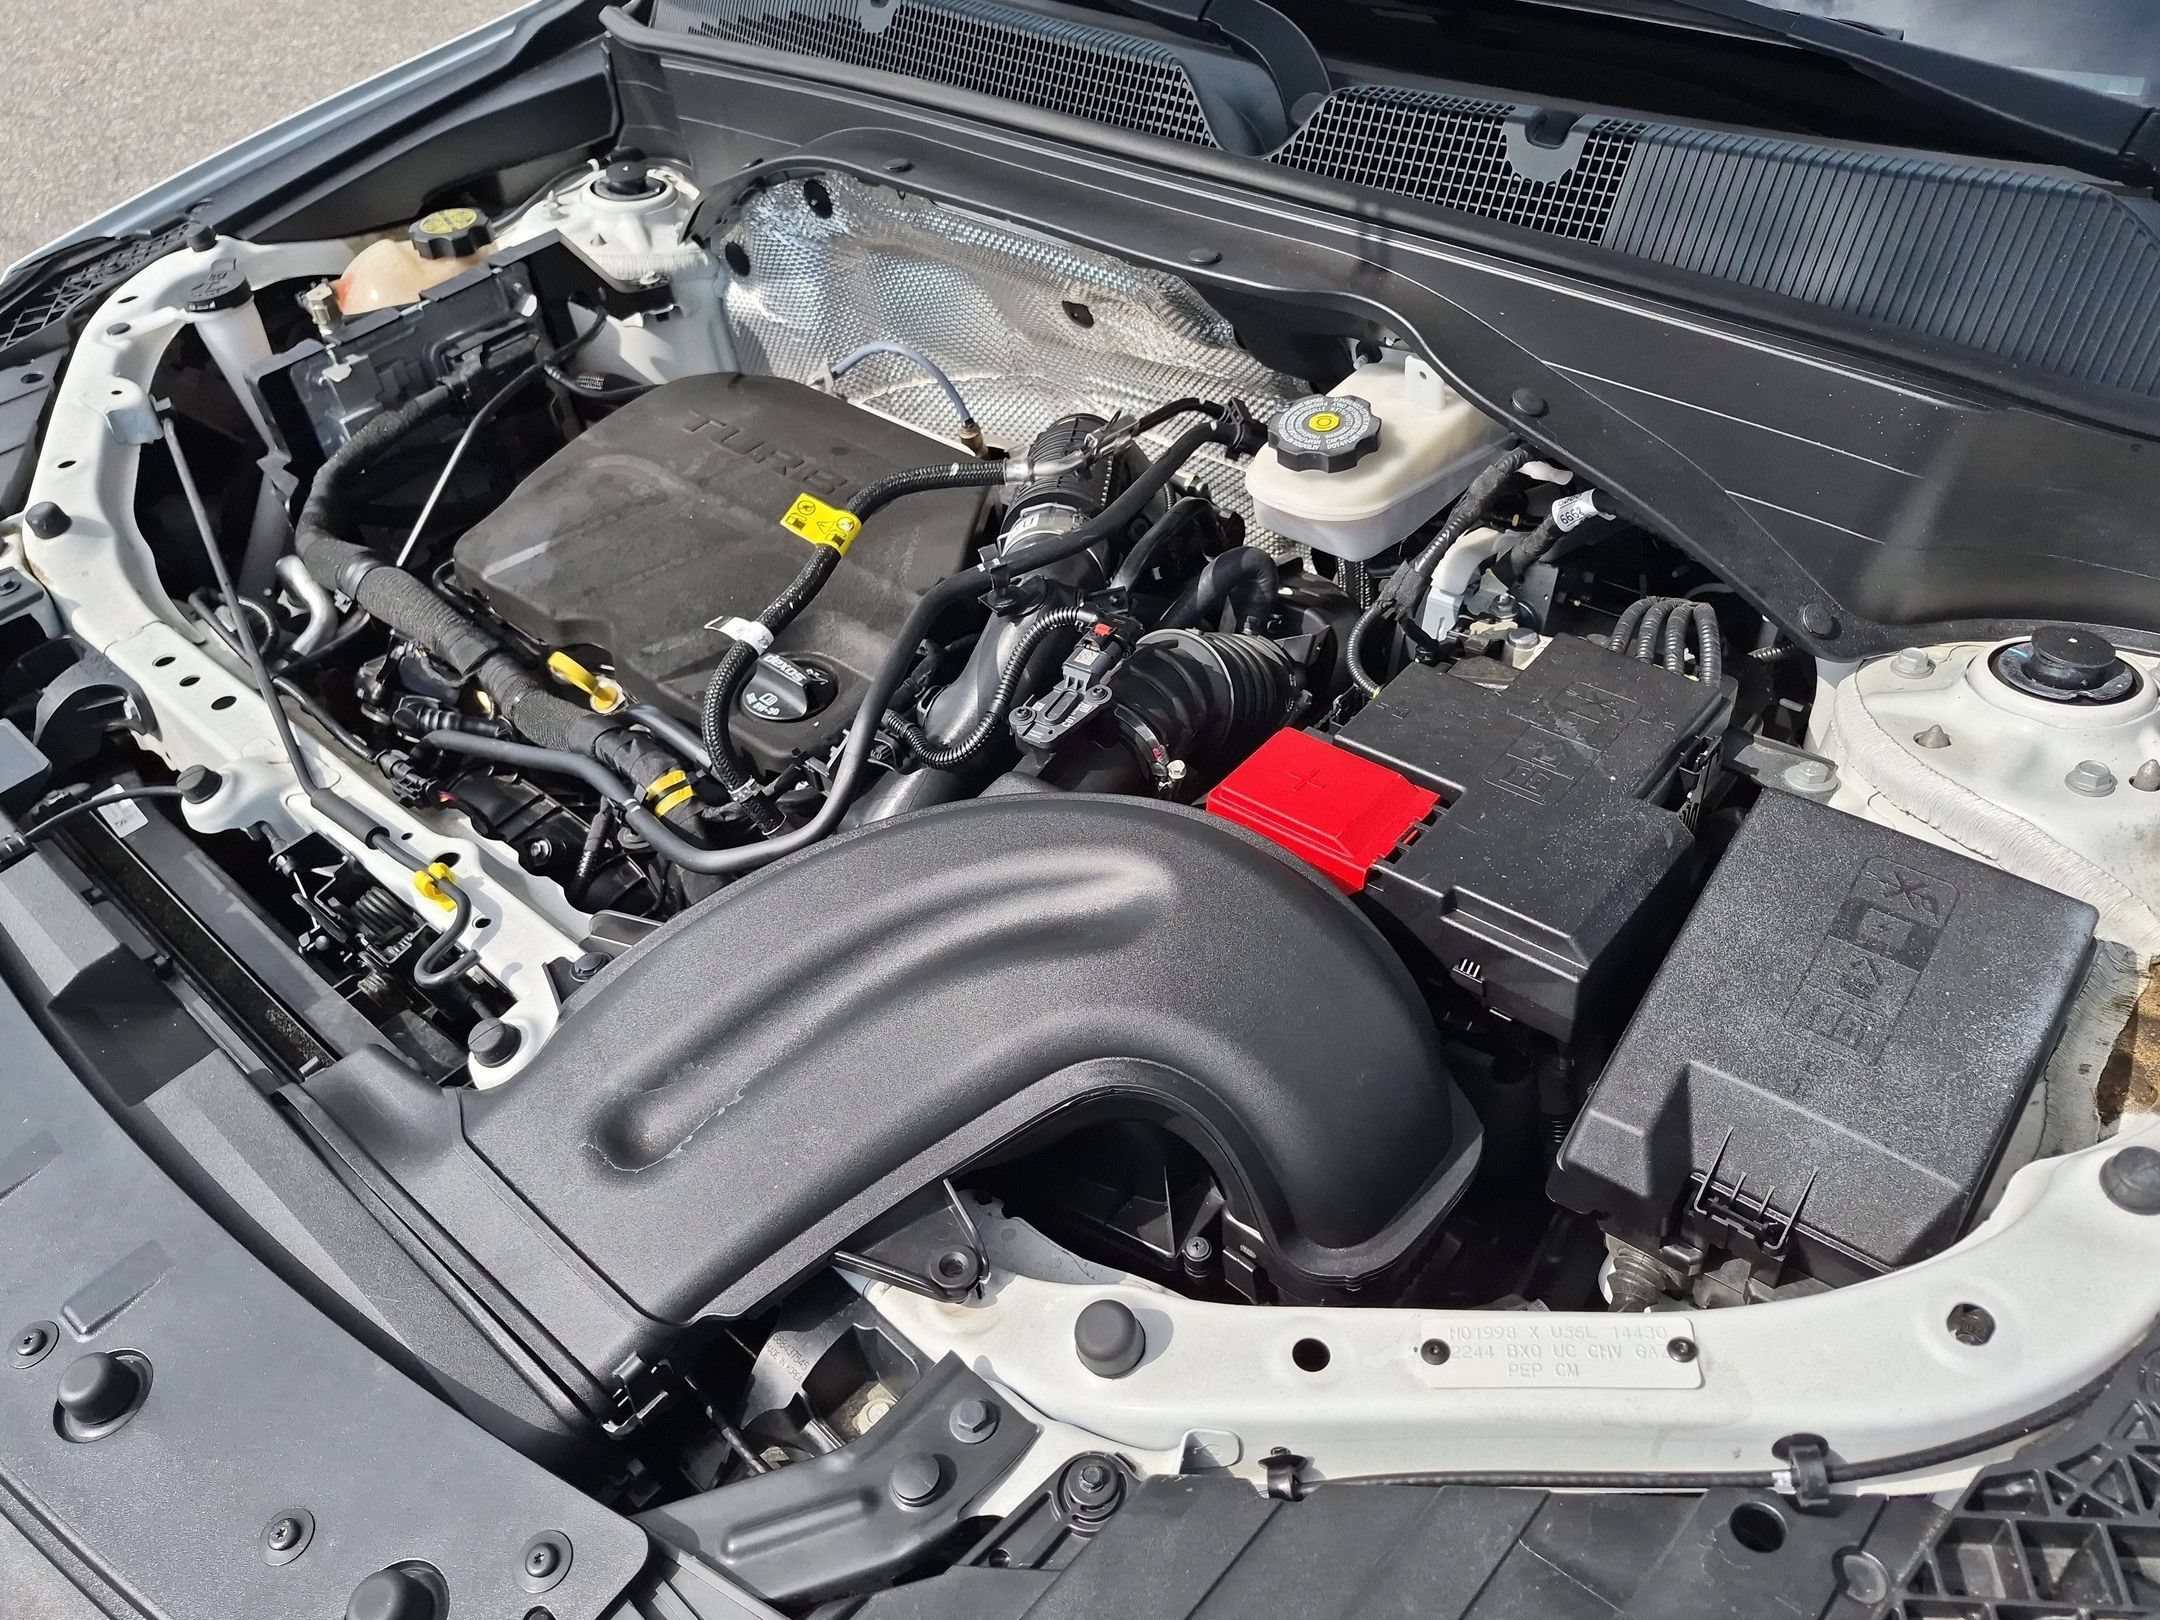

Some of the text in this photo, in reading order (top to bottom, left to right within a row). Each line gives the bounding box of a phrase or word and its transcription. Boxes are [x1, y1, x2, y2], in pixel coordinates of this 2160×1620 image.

[681, 407, 860, 499] TURB
[763, 654, 808, 682] dexos
[1529, 1325, 1540, 1341] X
[1551, 1343, 1577, 1360] UC
[1586, 1343, 1623, 1360] CHV
[1508, 1362, 1580, 1379] PEP CM
